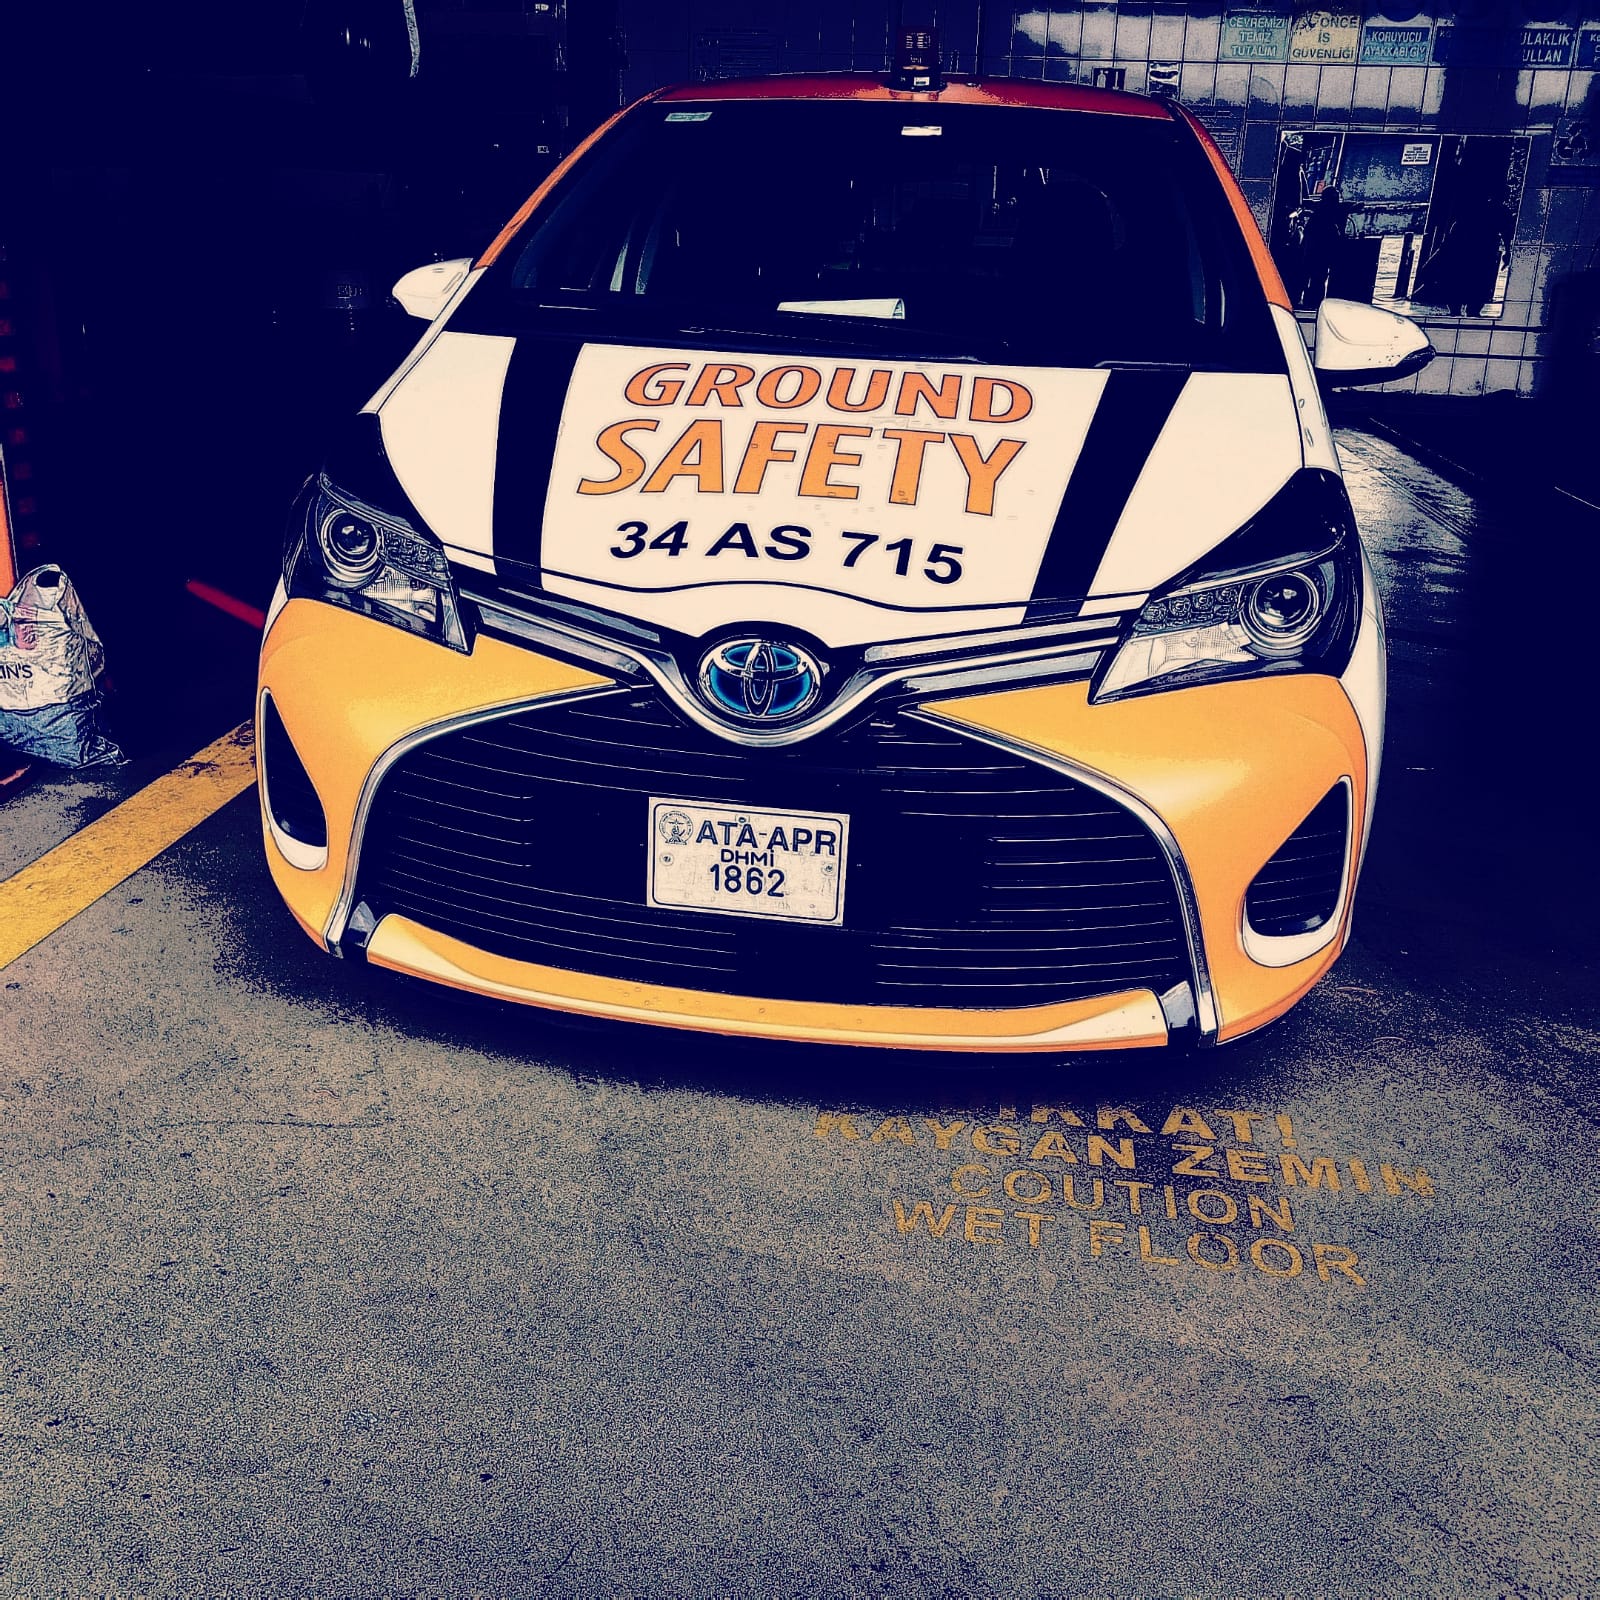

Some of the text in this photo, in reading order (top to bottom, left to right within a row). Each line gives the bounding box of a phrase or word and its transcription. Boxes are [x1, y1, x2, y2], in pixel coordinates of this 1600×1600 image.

[1231, 45, 1278, 57] TUTALIM
[1364, 46, 1408, 57] AYAKKABI
[1371, 31, 1422, 42] KORUYUCU
[1521, 32, 1570, 46] ULAKLIK
[1523, 49, 1562, 62] ULLAN
[624, 363, 1034, 423] GROUND
[577, 418, 1027, 517] SAFETY
[610, 520, 963, 585] 34 AS 715
[0, 663, 33, 679] IN'S
[695, 818, 837, 856] ATA-APR
[710, 863, 786, 898] 1862
[812, 1108, 1137, 1169] KAYGAN
[952, 1163, 1296, 1233] COUTION
[892, 1200, 1368, 1287] WET FLOOR
